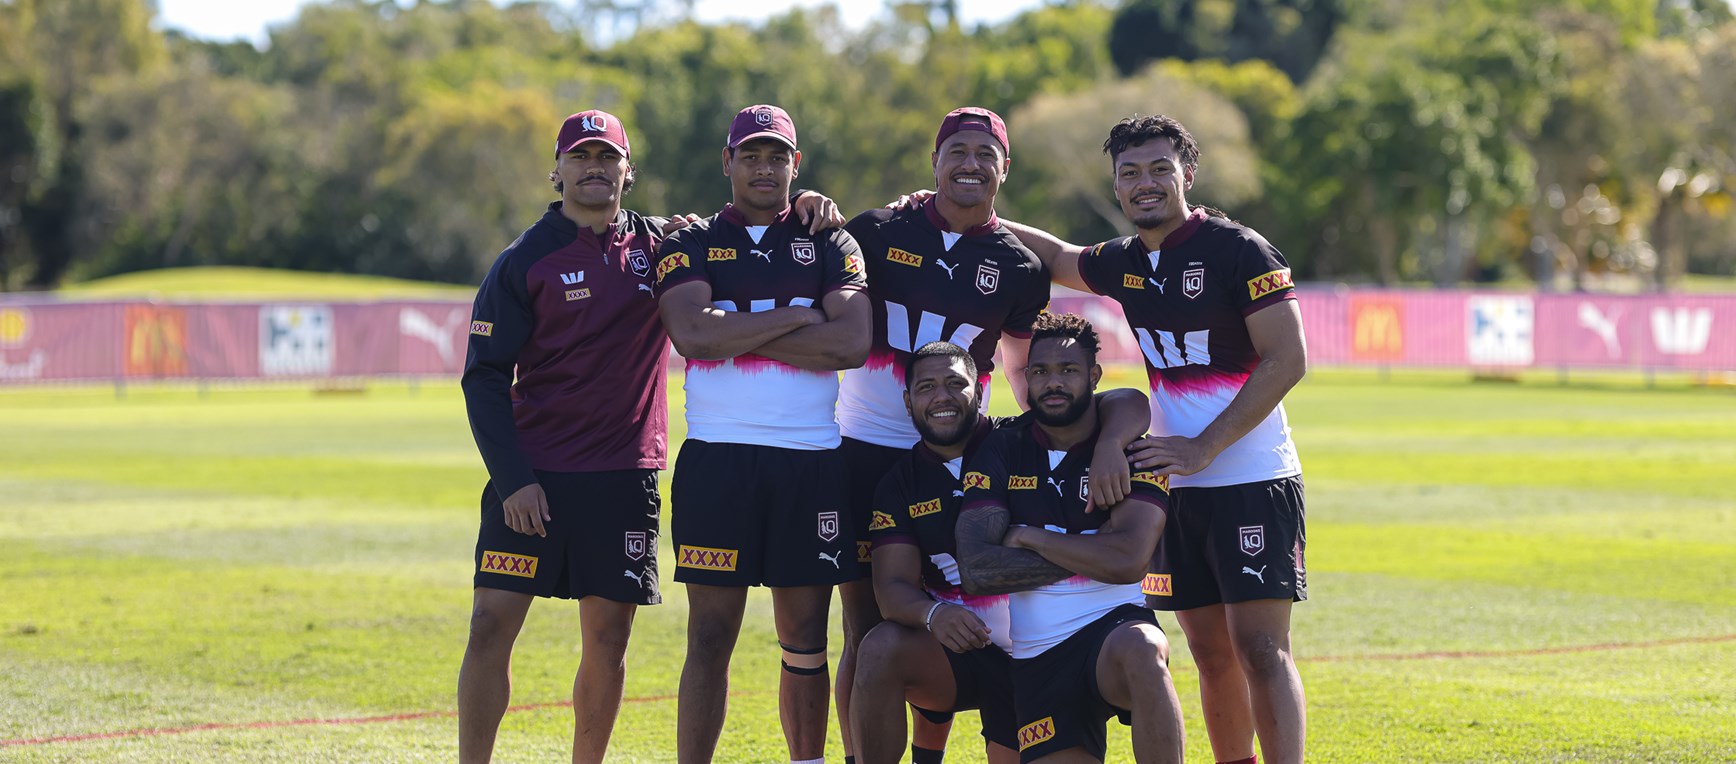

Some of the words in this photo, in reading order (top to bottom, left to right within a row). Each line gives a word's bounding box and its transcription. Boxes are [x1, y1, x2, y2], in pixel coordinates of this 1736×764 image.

[889, 249, 920, 264] XXXX
[568, 290, 588, 298] XXXX
[484, 554, 534, 575] XXXX
[681, 548, 734, 568] XXXX
[1020, 721, 1052, 747] XXX
